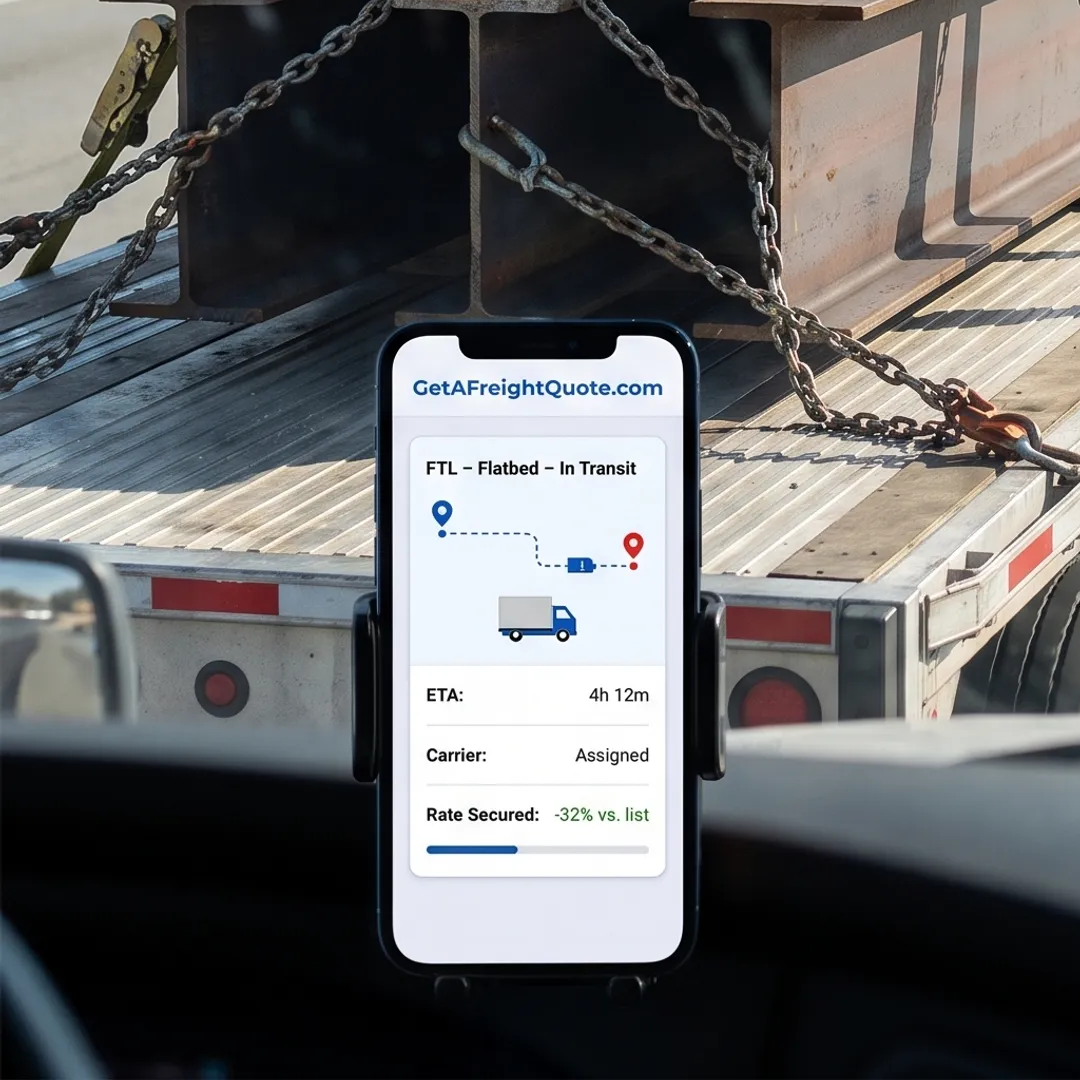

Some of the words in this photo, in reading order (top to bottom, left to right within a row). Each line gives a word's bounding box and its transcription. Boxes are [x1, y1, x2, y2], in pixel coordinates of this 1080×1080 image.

[412, 377, 663, 400] GetAFreightQuote.com
[426, 460, 458, 476] FTL
[477, 459, 539, 476] Flatbed
[559, 460, 575, 476] In
[578, 460, 637, 476] Transit
[426, 687, 464, 703] ETA:
[588, 686, 609, 703] 4h
[613, 687, 650, 703] 12m
[426, 747, 487, 763] Carrier:
[574, 746, 650, 767] Assigned
[426, 807, 464, 822] Rate
[467, 806, 540, 822] Secured:
[554, 806, 594, 822] -32%
[597, 810, 621, 822] vs.
[625, 806, 650, 822] list
